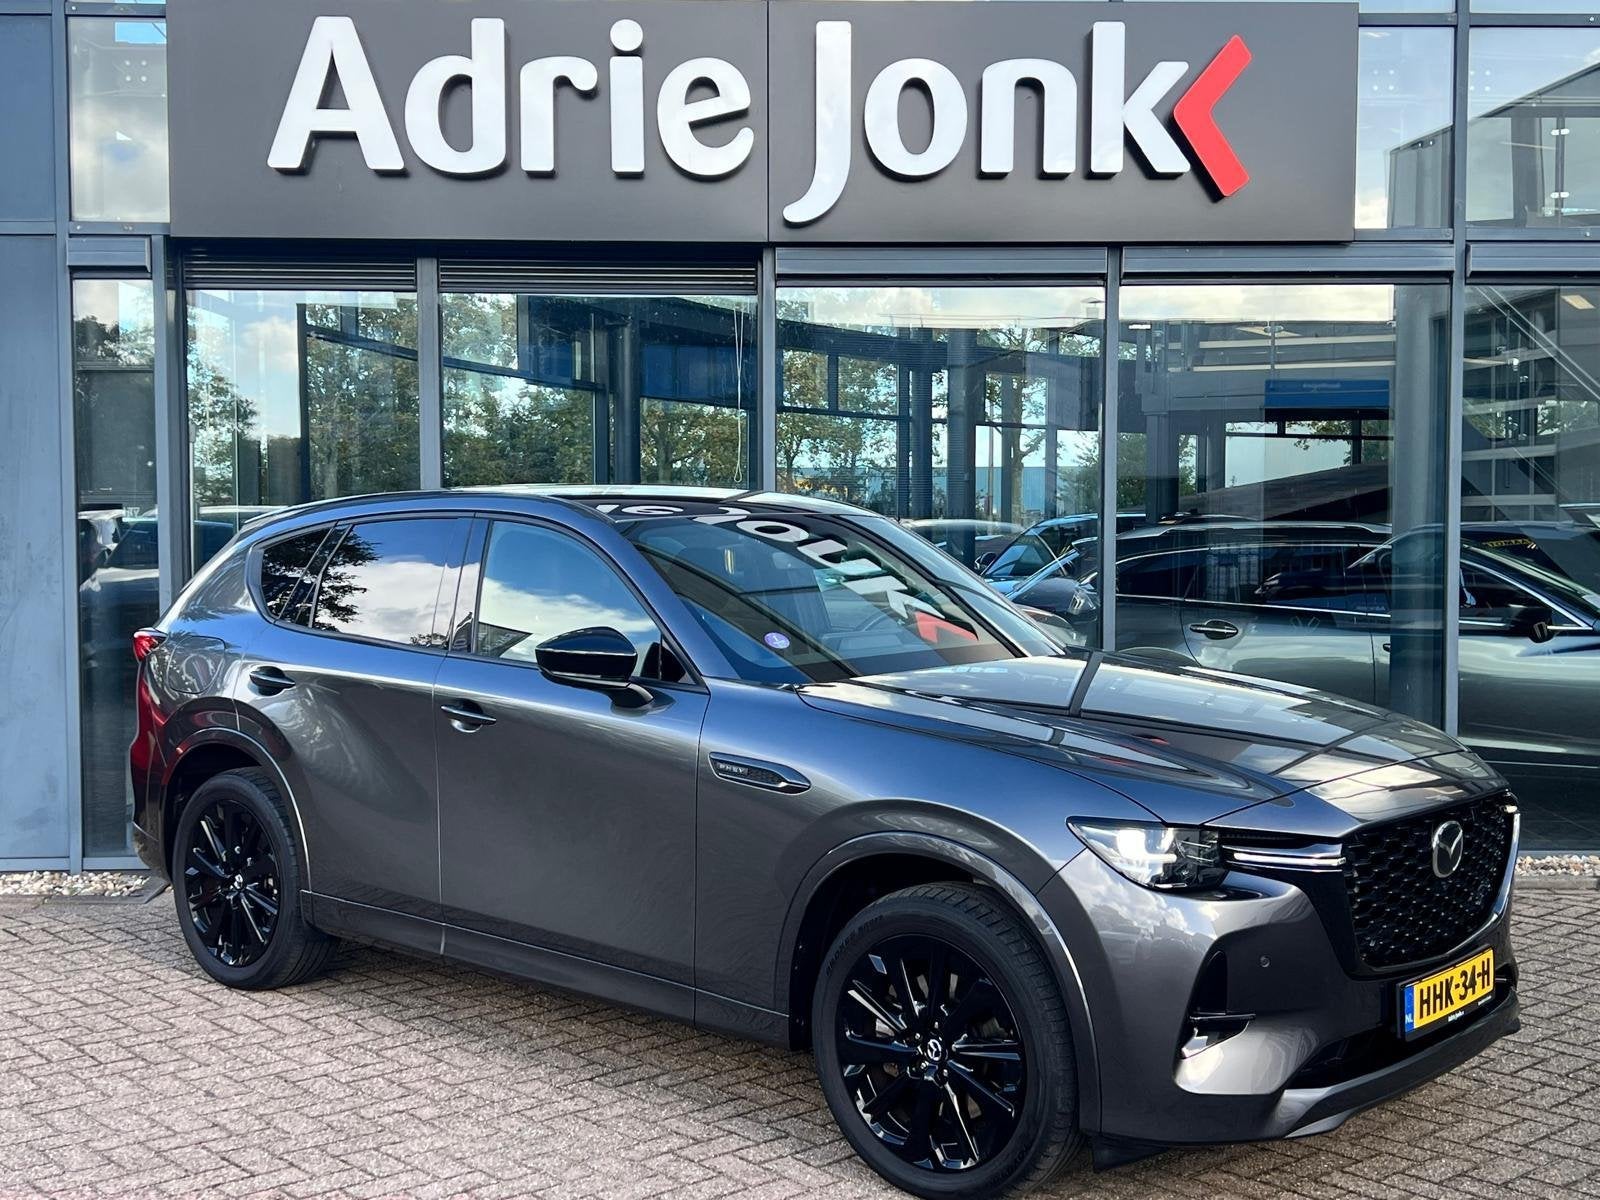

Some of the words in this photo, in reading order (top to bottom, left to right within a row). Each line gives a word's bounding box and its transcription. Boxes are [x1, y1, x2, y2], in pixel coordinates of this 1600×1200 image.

[267, 16, 755, 177] Adrie
[783, 20, 1191, 225] Jonk
[1405, 1013, 1414, 1024] NL
[1420, 958, 1490, 1019] HHK-34-H
